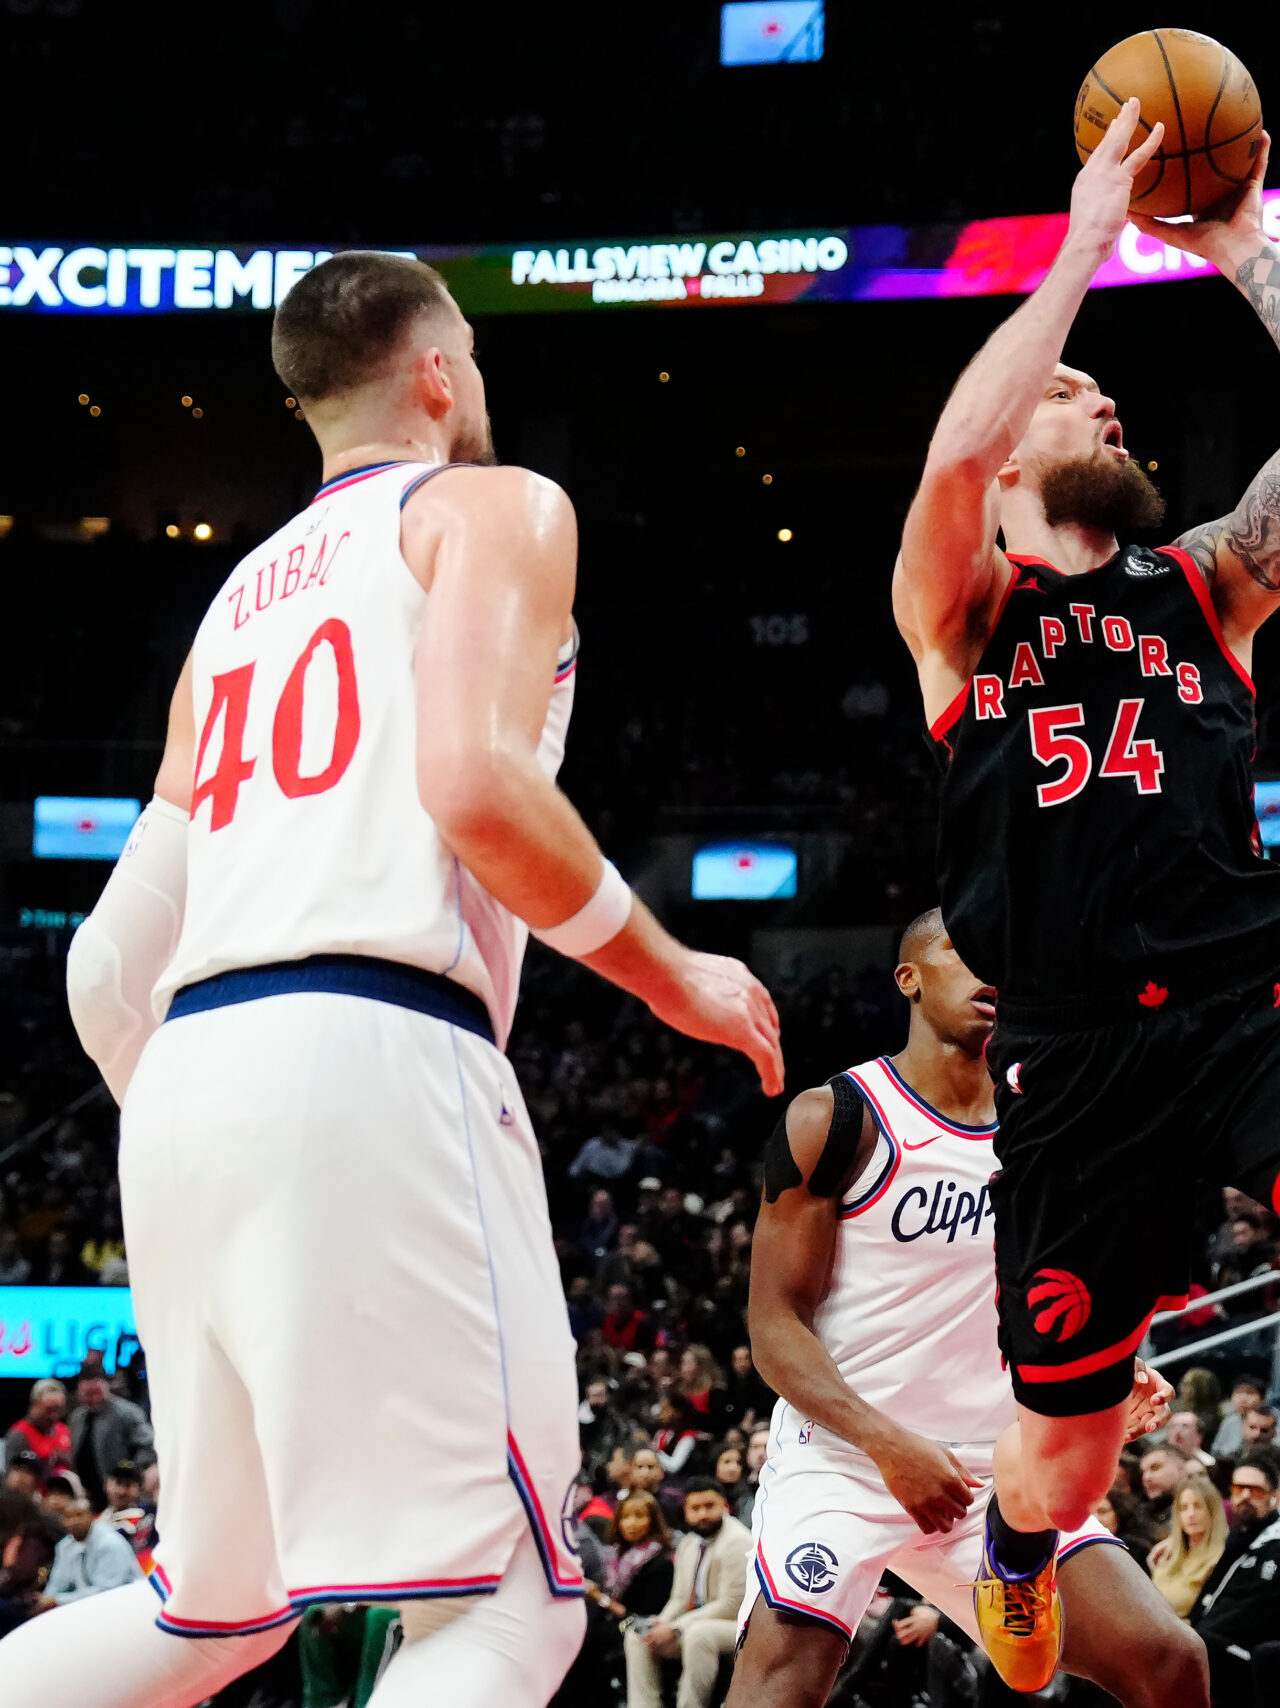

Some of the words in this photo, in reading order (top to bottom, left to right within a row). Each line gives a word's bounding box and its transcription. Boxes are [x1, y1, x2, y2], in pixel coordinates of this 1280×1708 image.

[0, 246, 418, 309] XCITEME
[511, 242, 707, 285] FALLSVIEW
[707, 236, 849, 276] CASINO
[700, 273, 765, 299] FALLS
[973, 602, 1204, 721] RAPTORS
[189, 617, 361, 833] 40
[1028, 698, 1165, 808] 54
